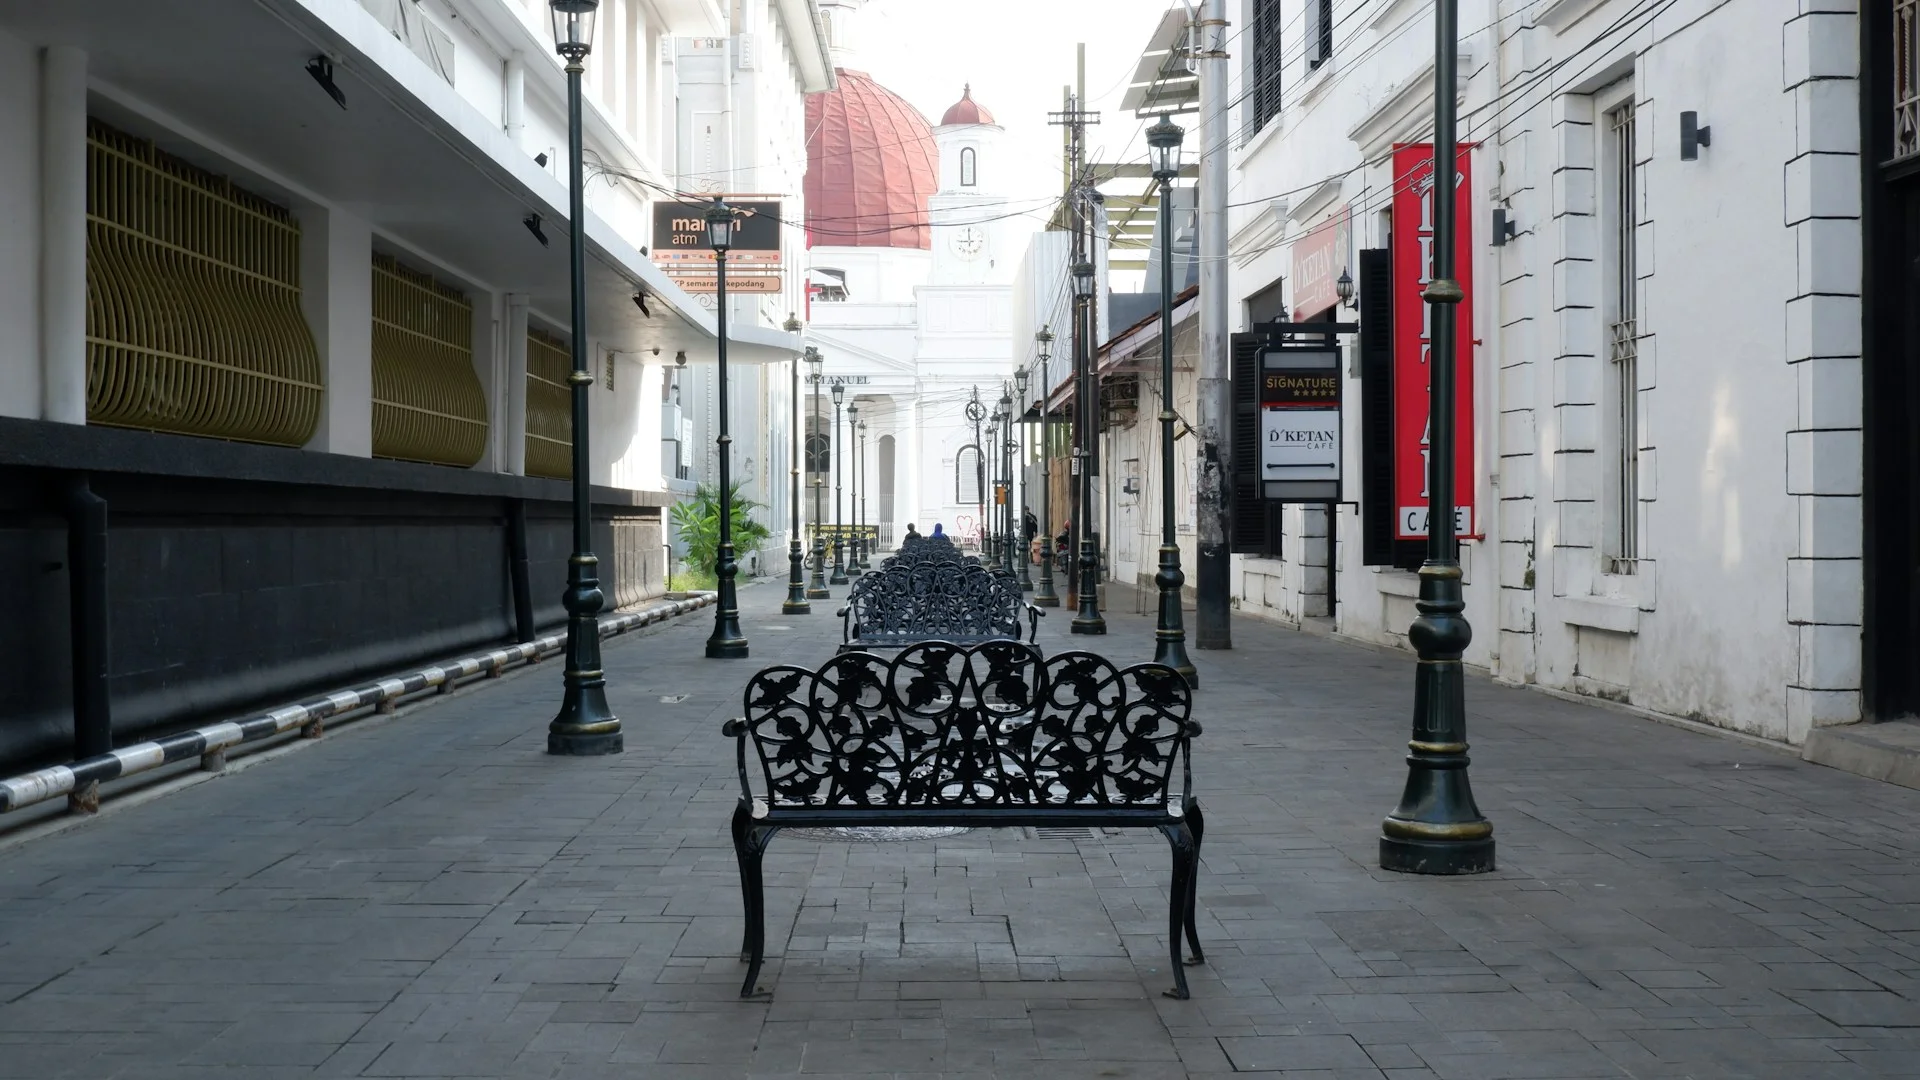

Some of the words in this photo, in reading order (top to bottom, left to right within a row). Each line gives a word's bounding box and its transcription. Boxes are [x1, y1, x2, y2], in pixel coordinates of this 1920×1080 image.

[672, 218, 741, 232] mari
[672, 233, 698, 245] atm
[726, 279, 765, 288] kepodang
[1266, 377, 1337, 389] SIGNATURE
